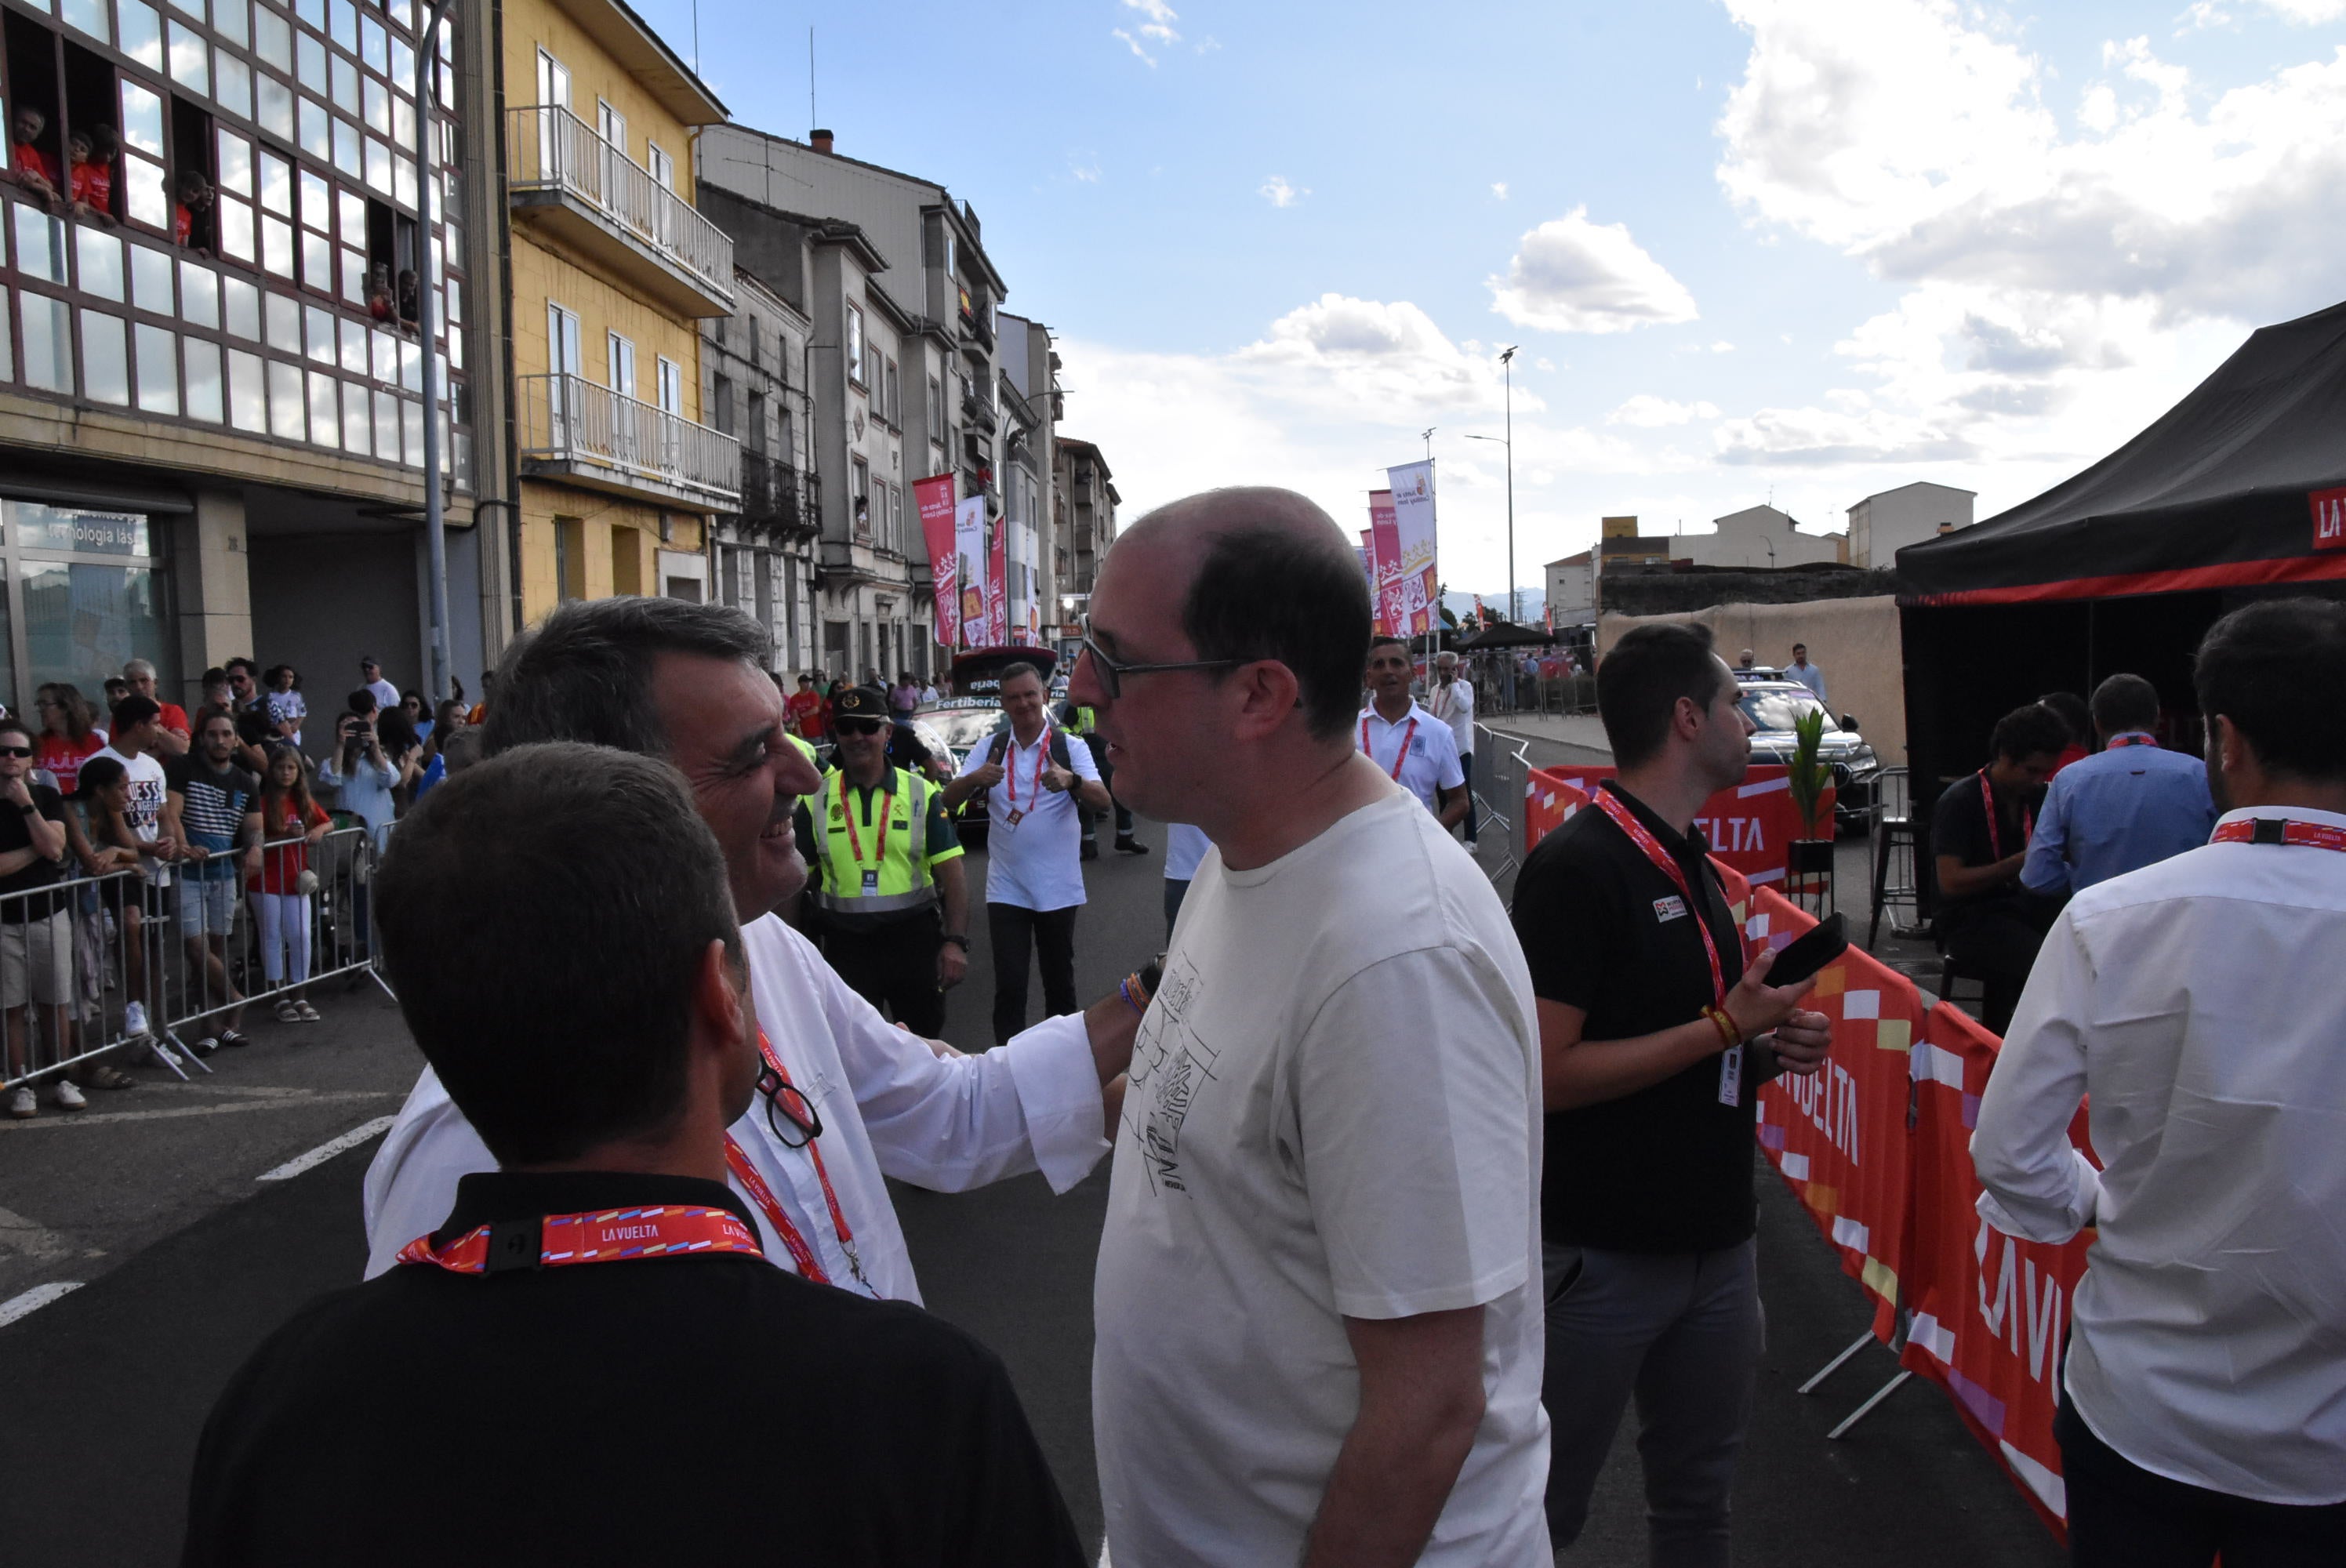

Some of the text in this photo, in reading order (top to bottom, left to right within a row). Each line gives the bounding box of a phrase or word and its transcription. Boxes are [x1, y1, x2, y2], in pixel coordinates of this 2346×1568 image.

[117, 527, 136, 544] lás
[935, 696, 1002, 710] Fertiberia
[127, 782, 160, 800] UESS
[748, 1176, 772, 1207] LA VUELTA
[602, 1224, 659, 1242] LA VUELTA
[722, 1223, 735, 1236] LA
